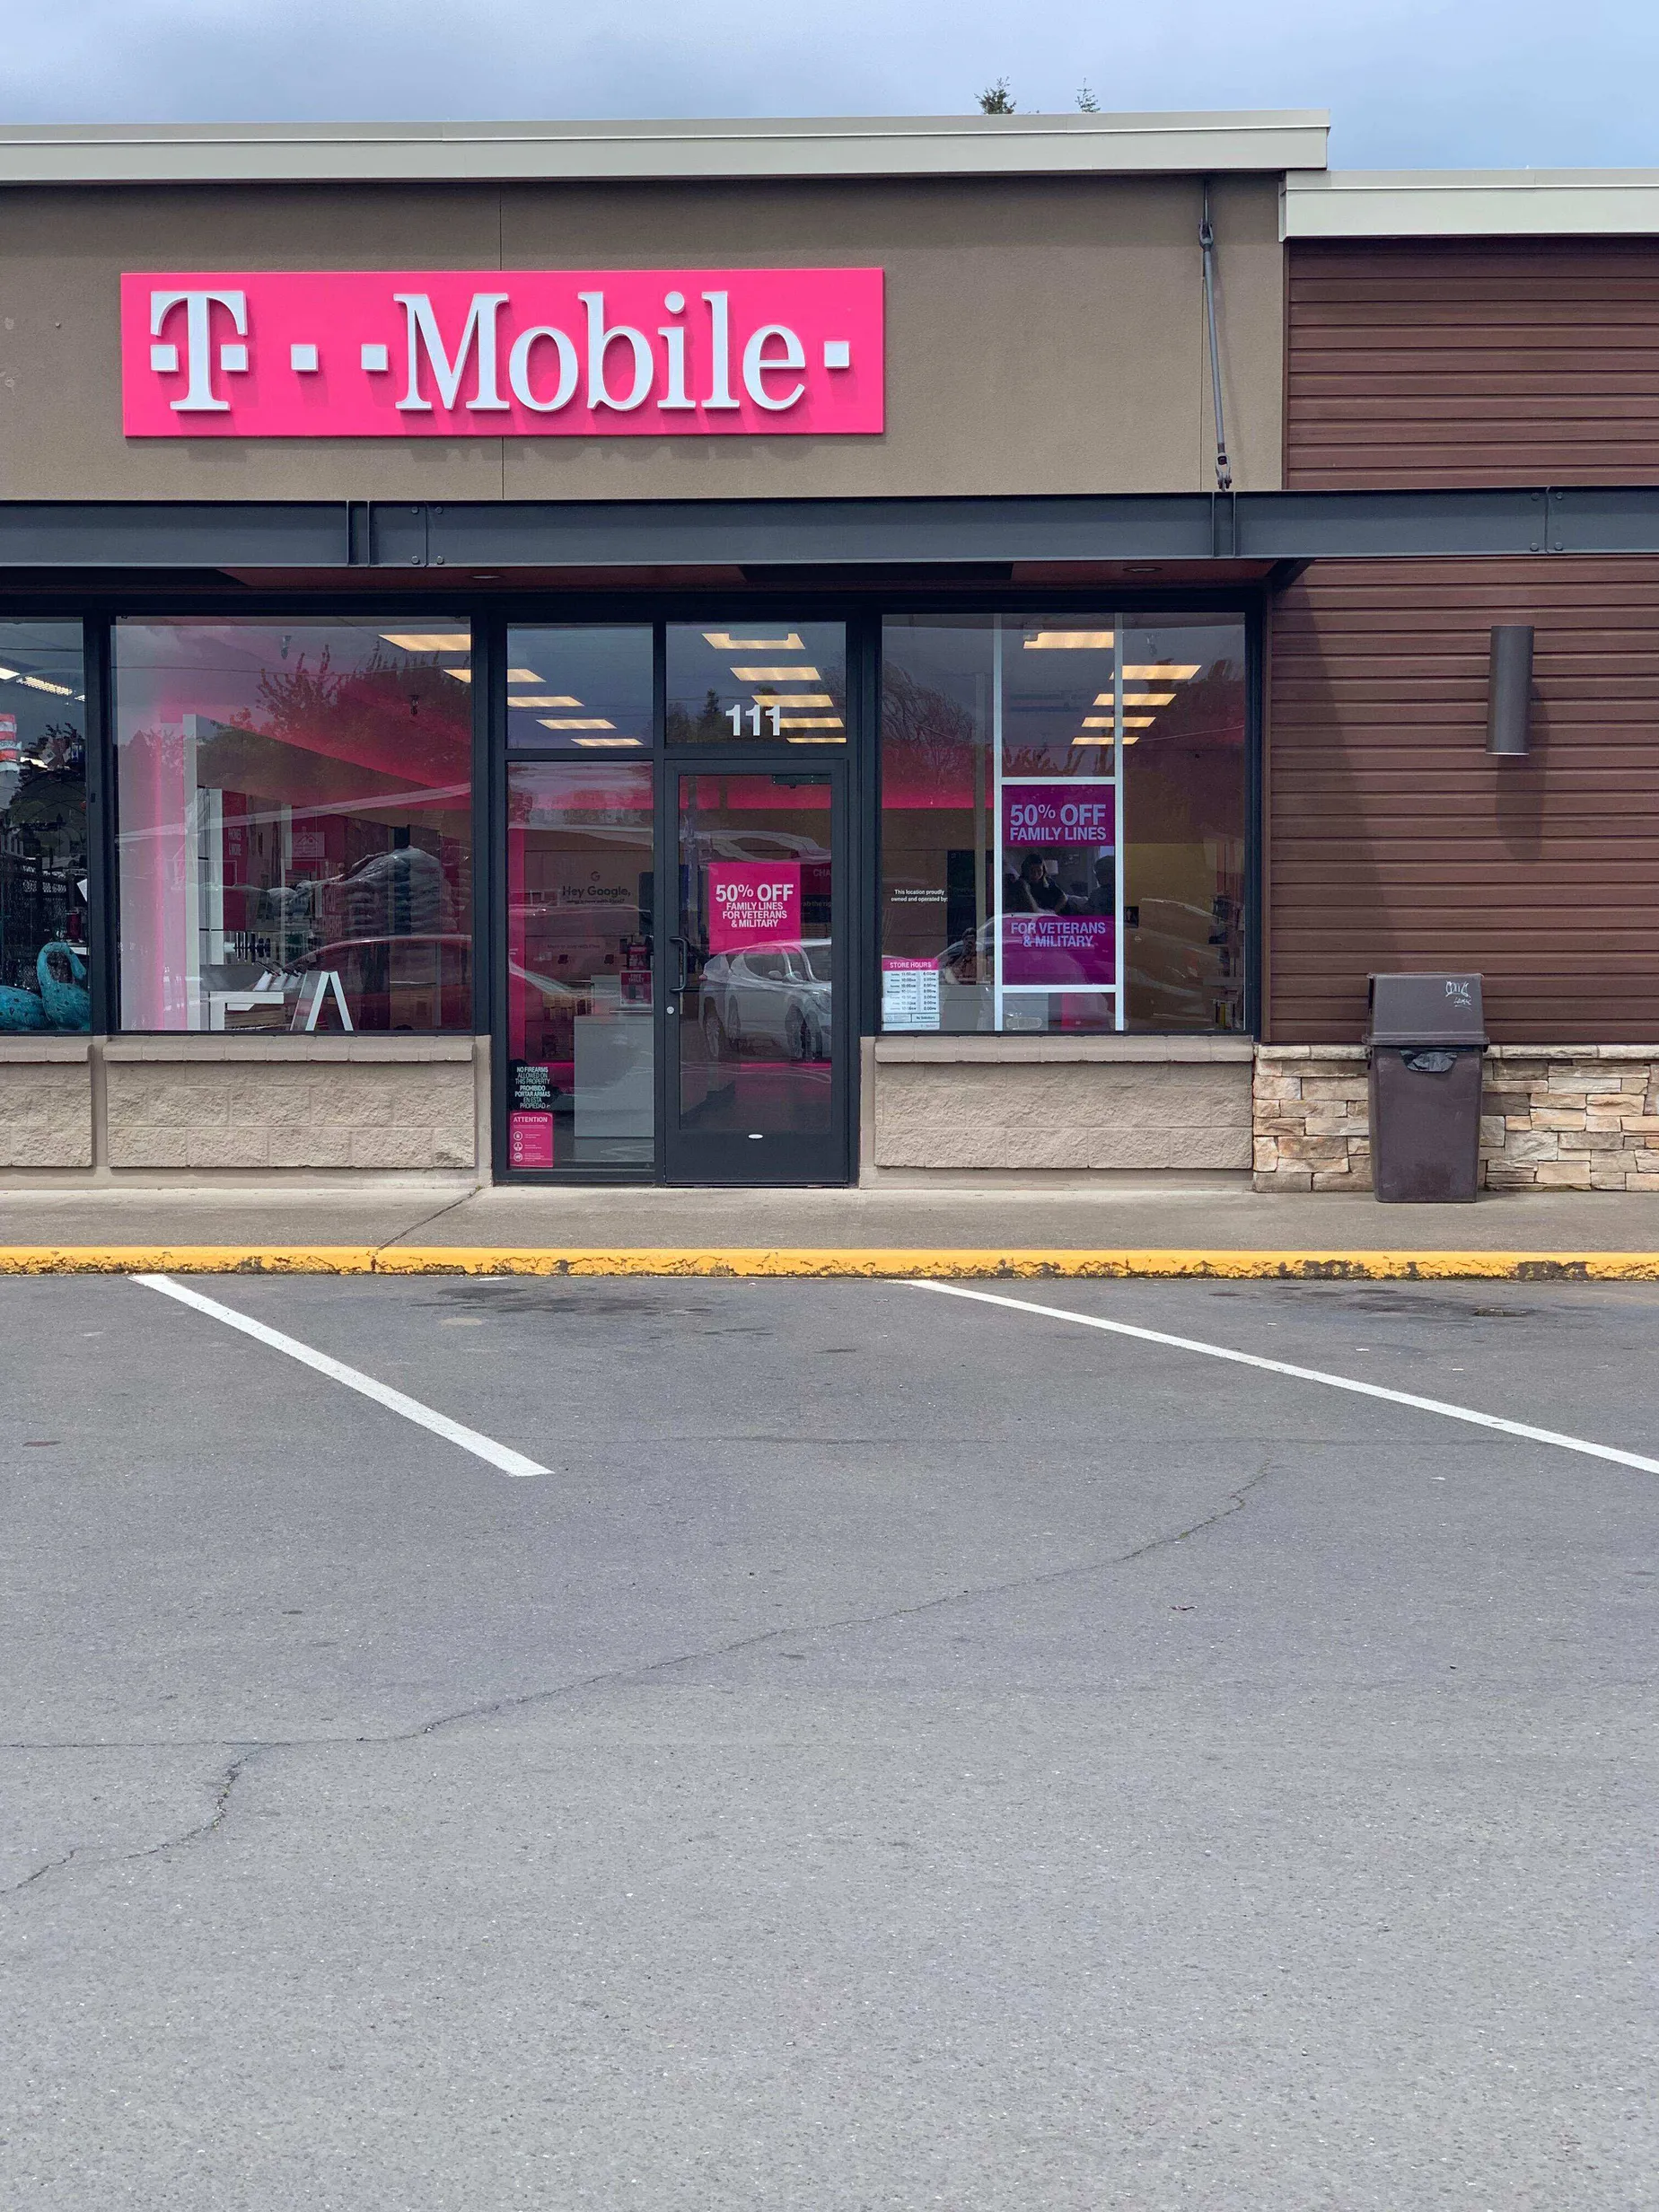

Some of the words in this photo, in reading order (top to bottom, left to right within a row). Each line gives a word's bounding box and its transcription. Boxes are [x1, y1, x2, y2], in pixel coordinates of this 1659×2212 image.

[725, 704, 780, 736] 111
[1010, 804, 1056, 826] 50%
[1060, 803, 1106, 826] OFF
[1010, 827, 1062, 840] FAMILY
[1065, 827, 1106, 840] LINES
[563, 886, 584, 898] Hey
[587, 886, 631, 898] Google,
[715, 884, 754, 902] 50%
[757, 883, 794, 901] OFF
[726, 902, 757, 910] FAMILY
[759, 902, 783, 910] LINES
[723, 911, 740, 919] FOR
[742, 910, 787, 919] VETERANS
[731, 919, 737, 927] &
[739, 919, 778, 927] MILITARY
[1011, 922, 1036, 935] FOR
[1040, 922, 1106, 935] VETERANS
[1023, 935, 1032, 947] &
[1035, 935, 1093, 947] MILITARY
